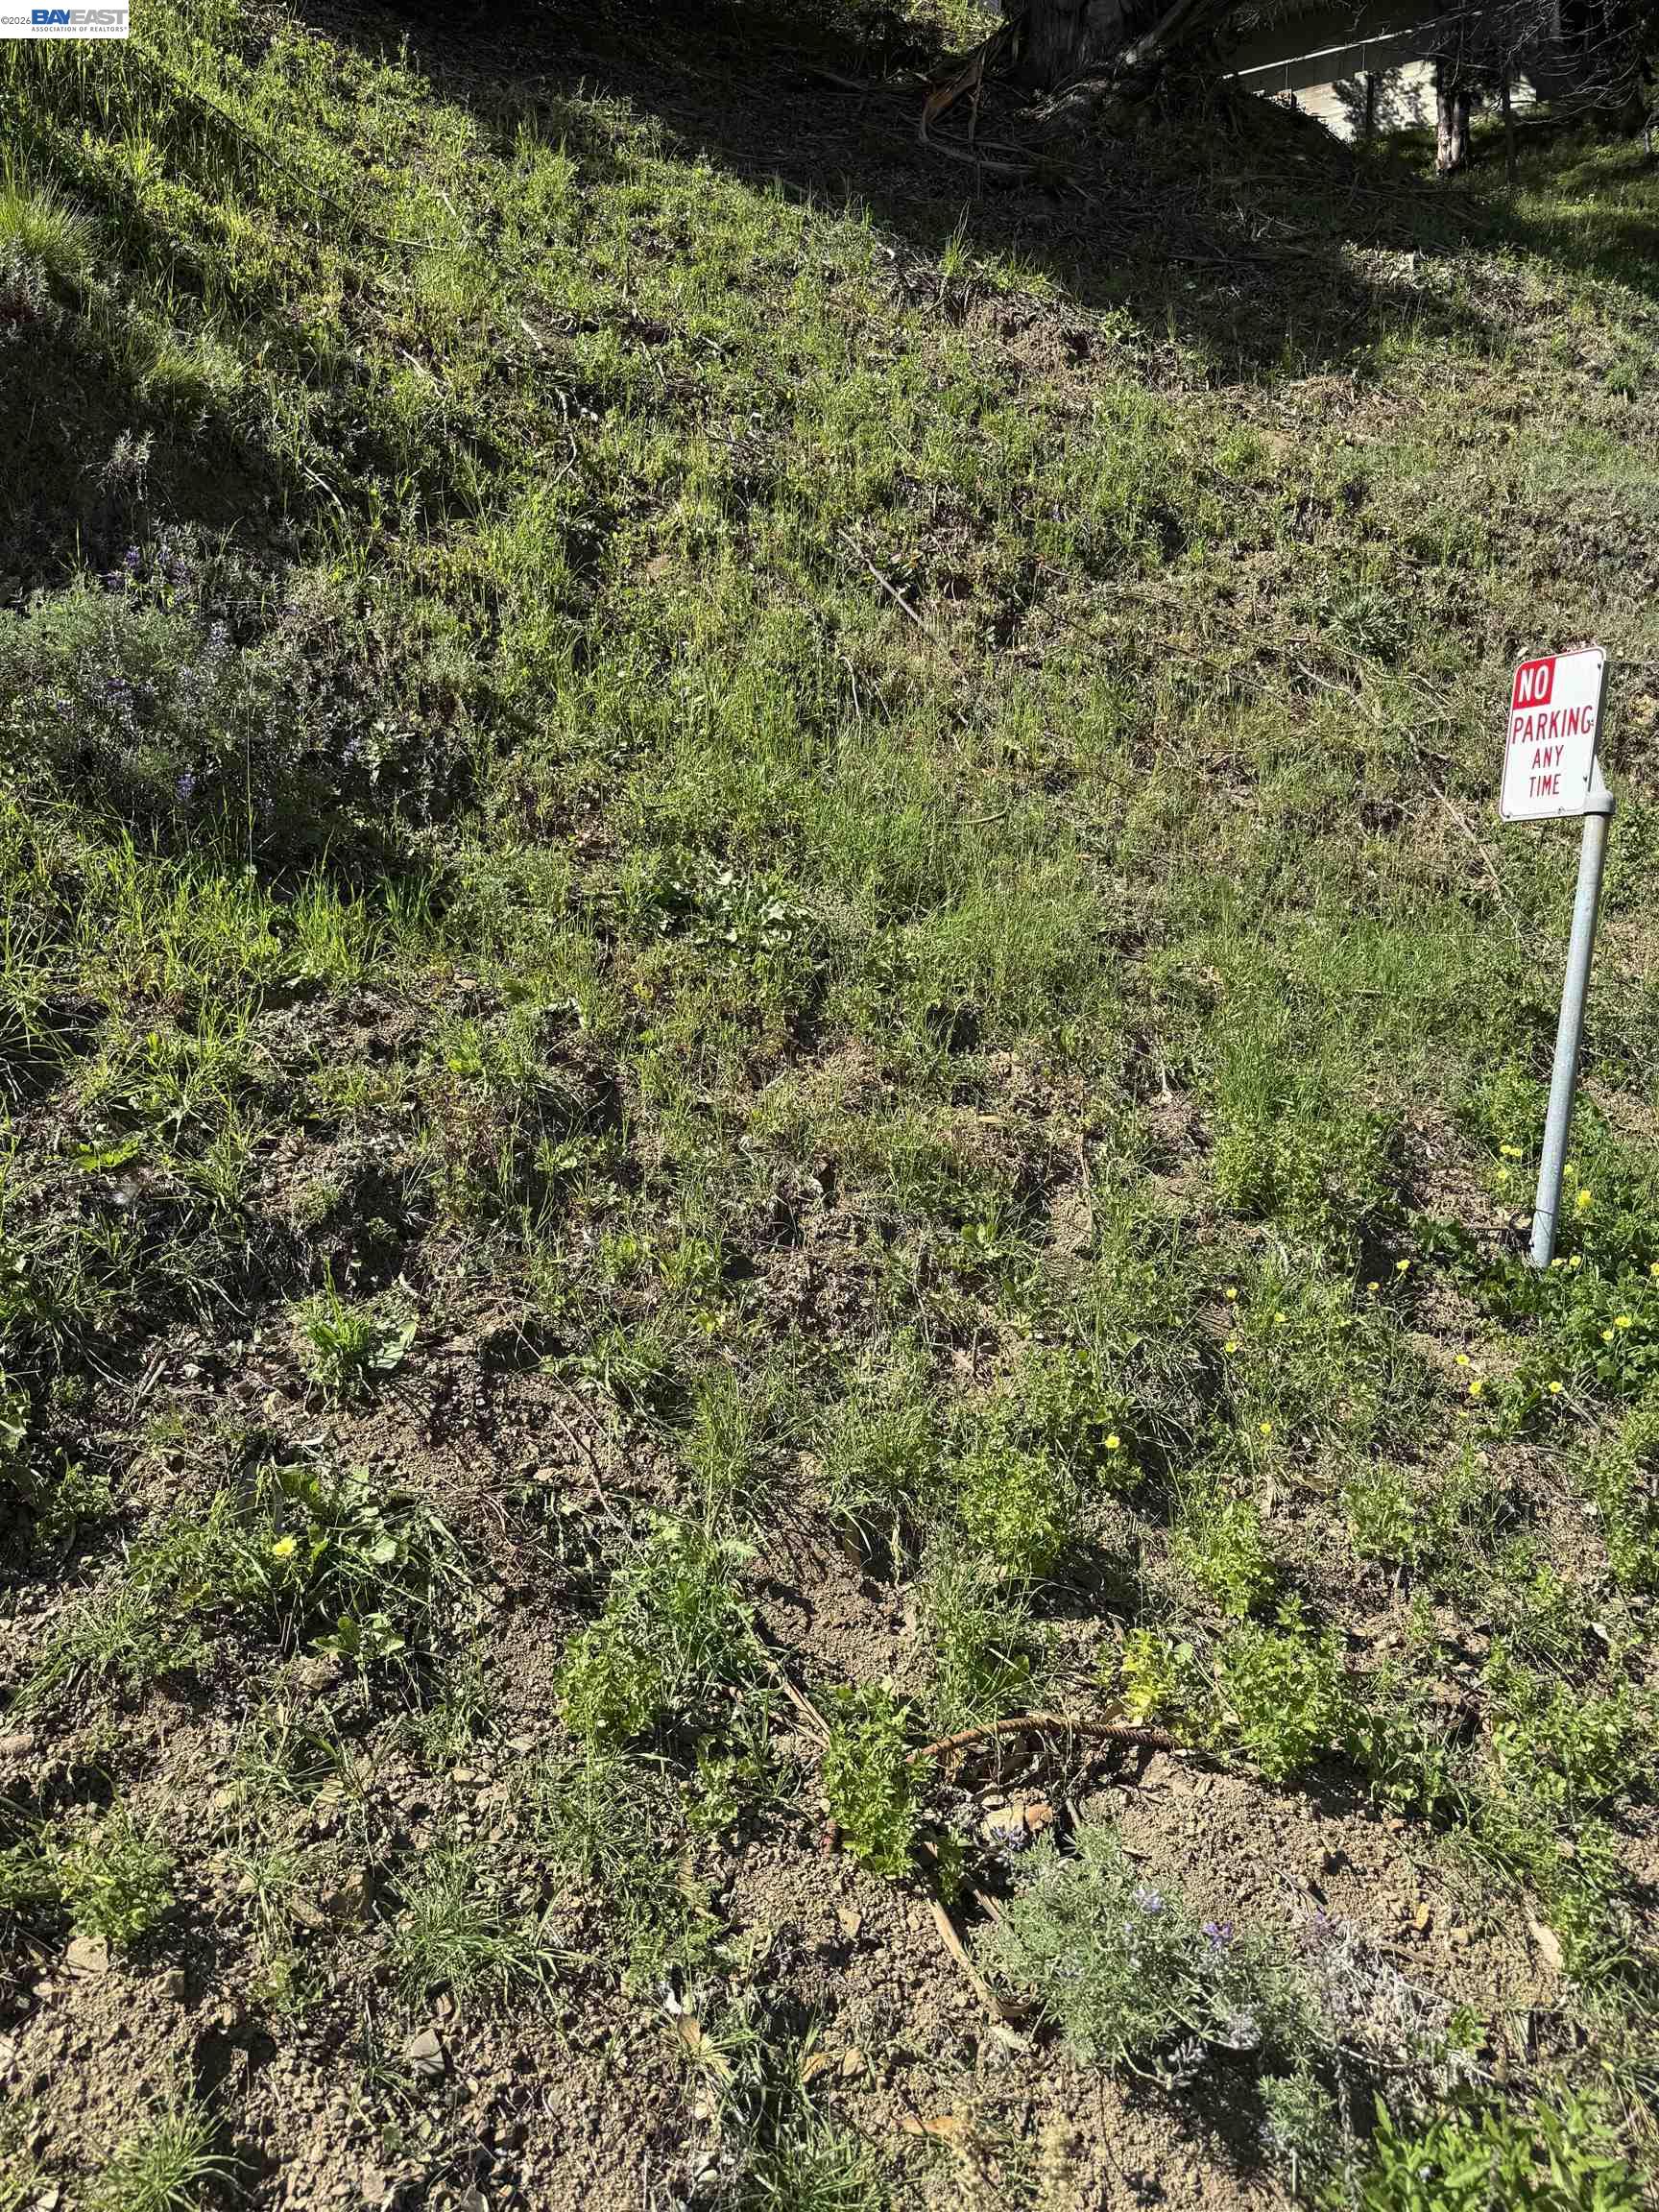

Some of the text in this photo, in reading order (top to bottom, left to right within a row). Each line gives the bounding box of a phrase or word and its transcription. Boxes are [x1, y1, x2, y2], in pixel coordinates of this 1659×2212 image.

[1518, 664, 1550, 704] NO
[1512, 705, 1594, 744] PARKING
[1532, 744, 1565, 769] ANY
[1529, 773, 1562, 798] TIME
